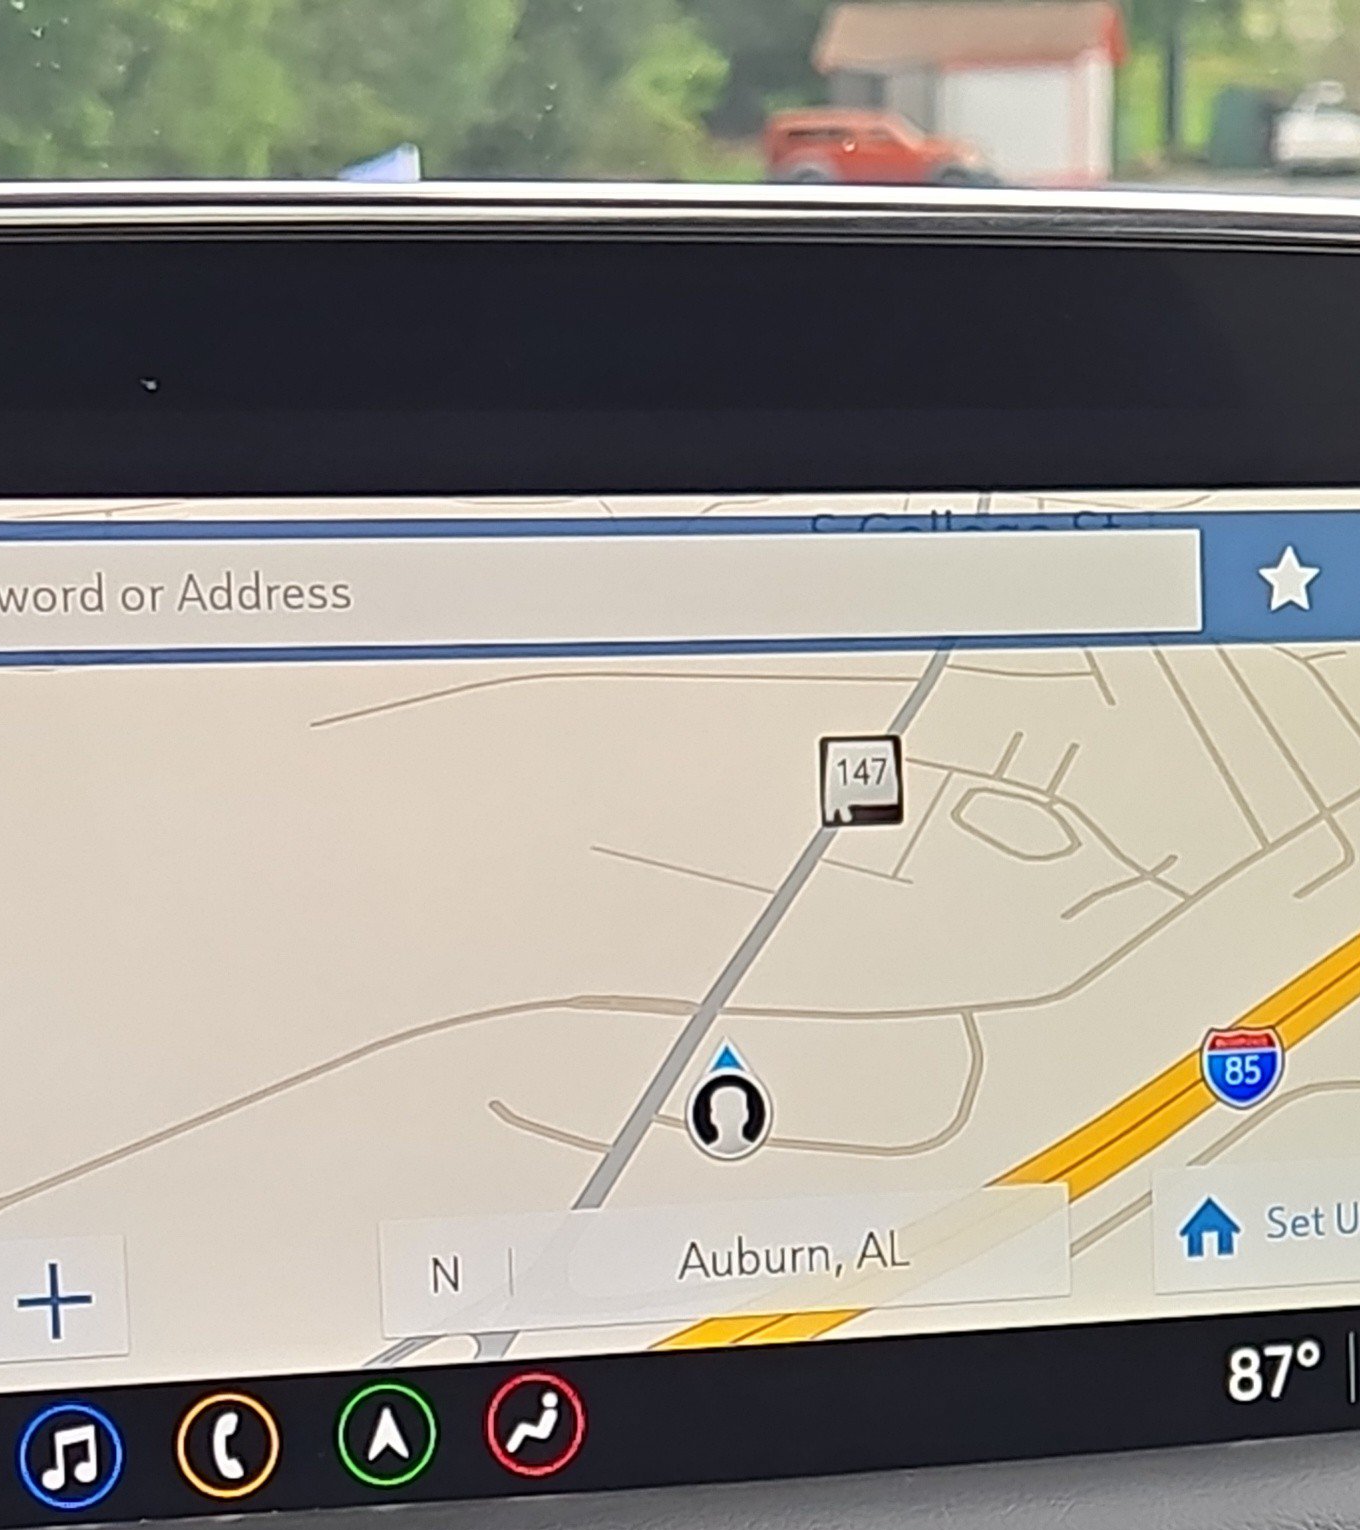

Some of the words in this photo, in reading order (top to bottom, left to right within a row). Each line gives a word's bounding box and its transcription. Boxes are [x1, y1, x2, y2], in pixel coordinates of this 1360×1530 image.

[121, 582, 162, 613] or
[177, 572, 353, 613] Address
[837, 758, 887, 786] 147
[1225, 1055, 1261, 1086] 85
[1267, 1206, 1325, 1239] Set
[678, 1236, 843, 1279] Auburn,
[857, 1229, 910, 1270] AL
[432, 1256, 459, 1293] N
[1228, 1340, 1321, 1402] 87°
